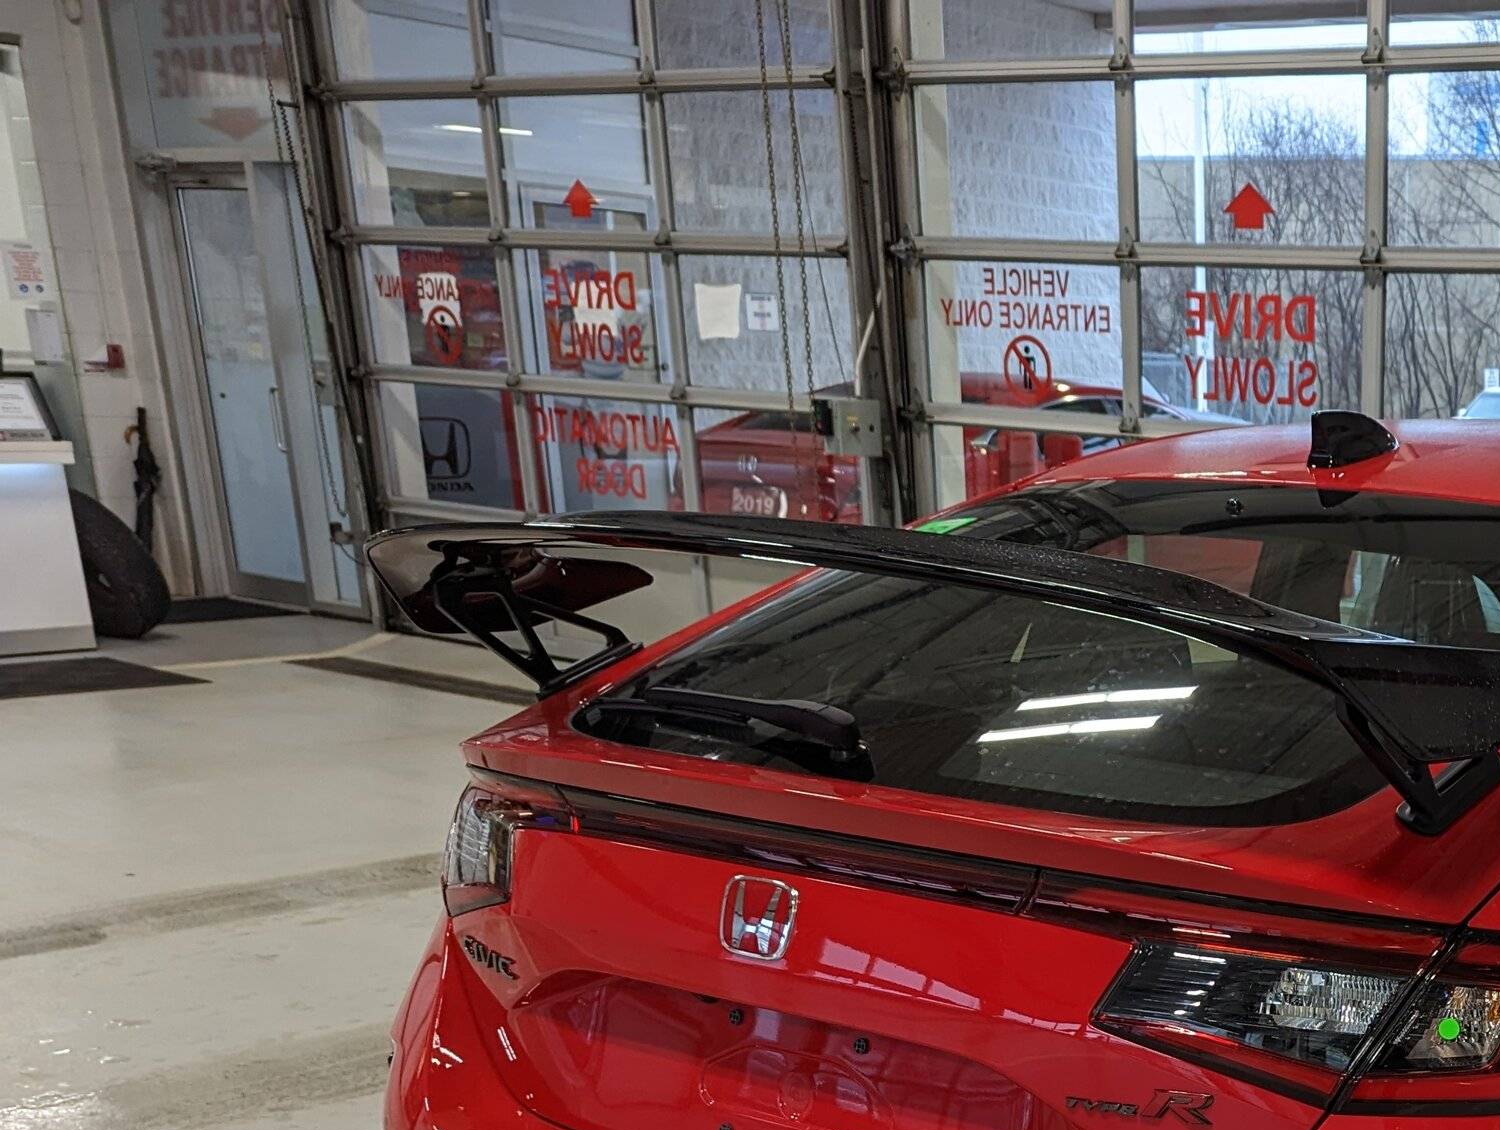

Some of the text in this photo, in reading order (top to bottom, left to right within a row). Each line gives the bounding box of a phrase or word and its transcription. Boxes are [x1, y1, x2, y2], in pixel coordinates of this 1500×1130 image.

[732, 494, 776, 516] 2019
[464, 935, 521, 980] CIVIC
[1065, 1088, 1215, 1126] TYPE R
